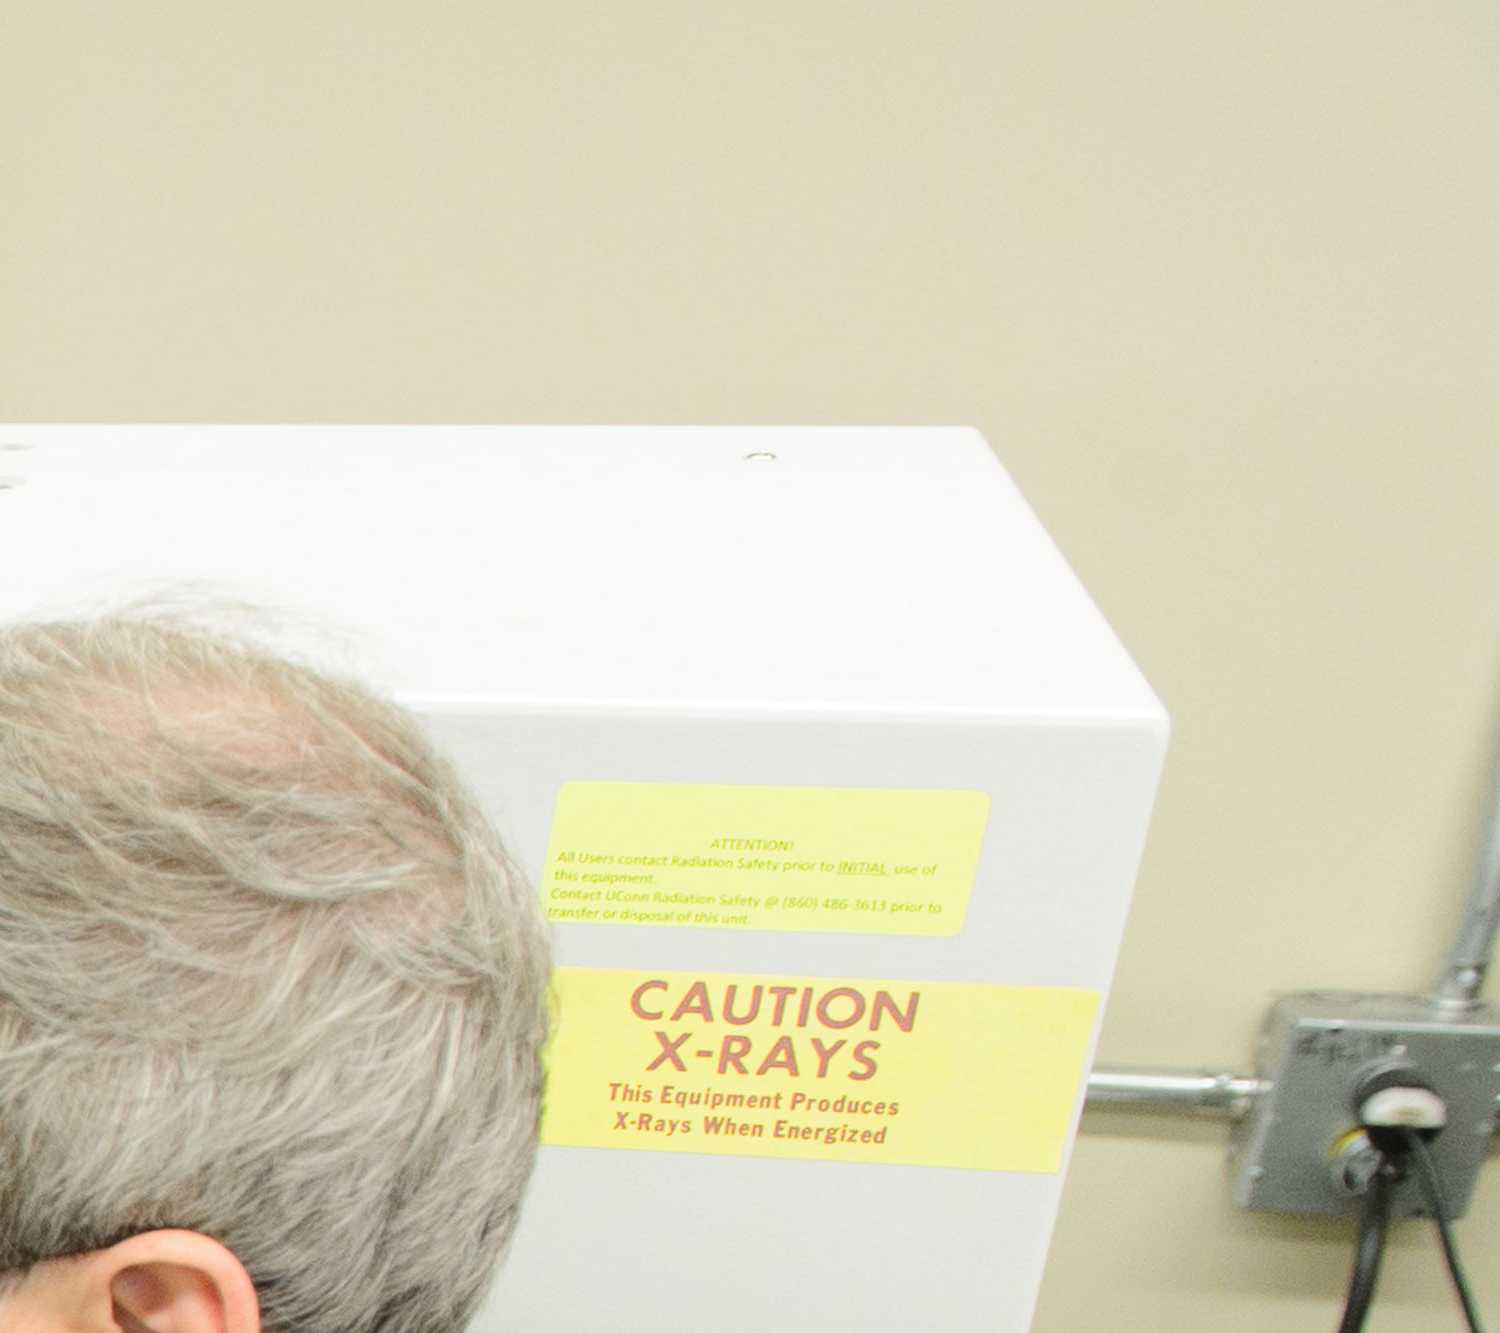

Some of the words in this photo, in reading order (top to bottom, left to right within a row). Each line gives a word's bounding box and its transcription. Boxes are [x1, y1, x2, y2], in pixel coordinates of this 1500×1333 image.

[709, 837, 795, 852] ATTENTION!
[554, 870, 579, 882] this
[581, 871, 658, 885] equipment.
[556, 851, 576, 863] All
[578, 852, 615, 865] Users
[617, 855, 668, 867] contact
[670, 855, 734, 869] Radiation
[737, 857, 781, 873] Safety
[782, 861, 816, 873] prior
[819, 861, 835, 873] to
[837, 861, 888, 875] INITIAL
[894, 865, 918, 876] use
[921, 863, 938, 877] of
[550, 887, 602, 901] Contact
[605, 889, 650, 902] UConn
[652, 890, 716, 905] Radiation
[718, 893, 762, 908] Safety
[764, 895, 779, 909] @
[781, 896, 818, 911] (860)
[821, 897, 887, 912] 486-3613
[889, 900, 924, 915] prior
[927, 902, 942, 914] to
[547, 906, 600, 919] transfer
[603, 909, 616, 919] or
[620, 908, 674, 923] disposal
[677, 910, 692, 922] of
[694, 912, 718, 924] this
[721, 913, 752, 925] unit.
[629, 979, 921, 1034] CAUTION
[644, 1030, 882, 1082] X-RAYS
[608, 1082, 653, 1104] This
[660, 1085, 783, 1111] Equipment
[789, 1091, 900, 1116] Produces
[613, 1111, 692, 1136] X-Rays
[703, 1115, 765, 1137] When
[772, 1119, 888, 1145] Energized
